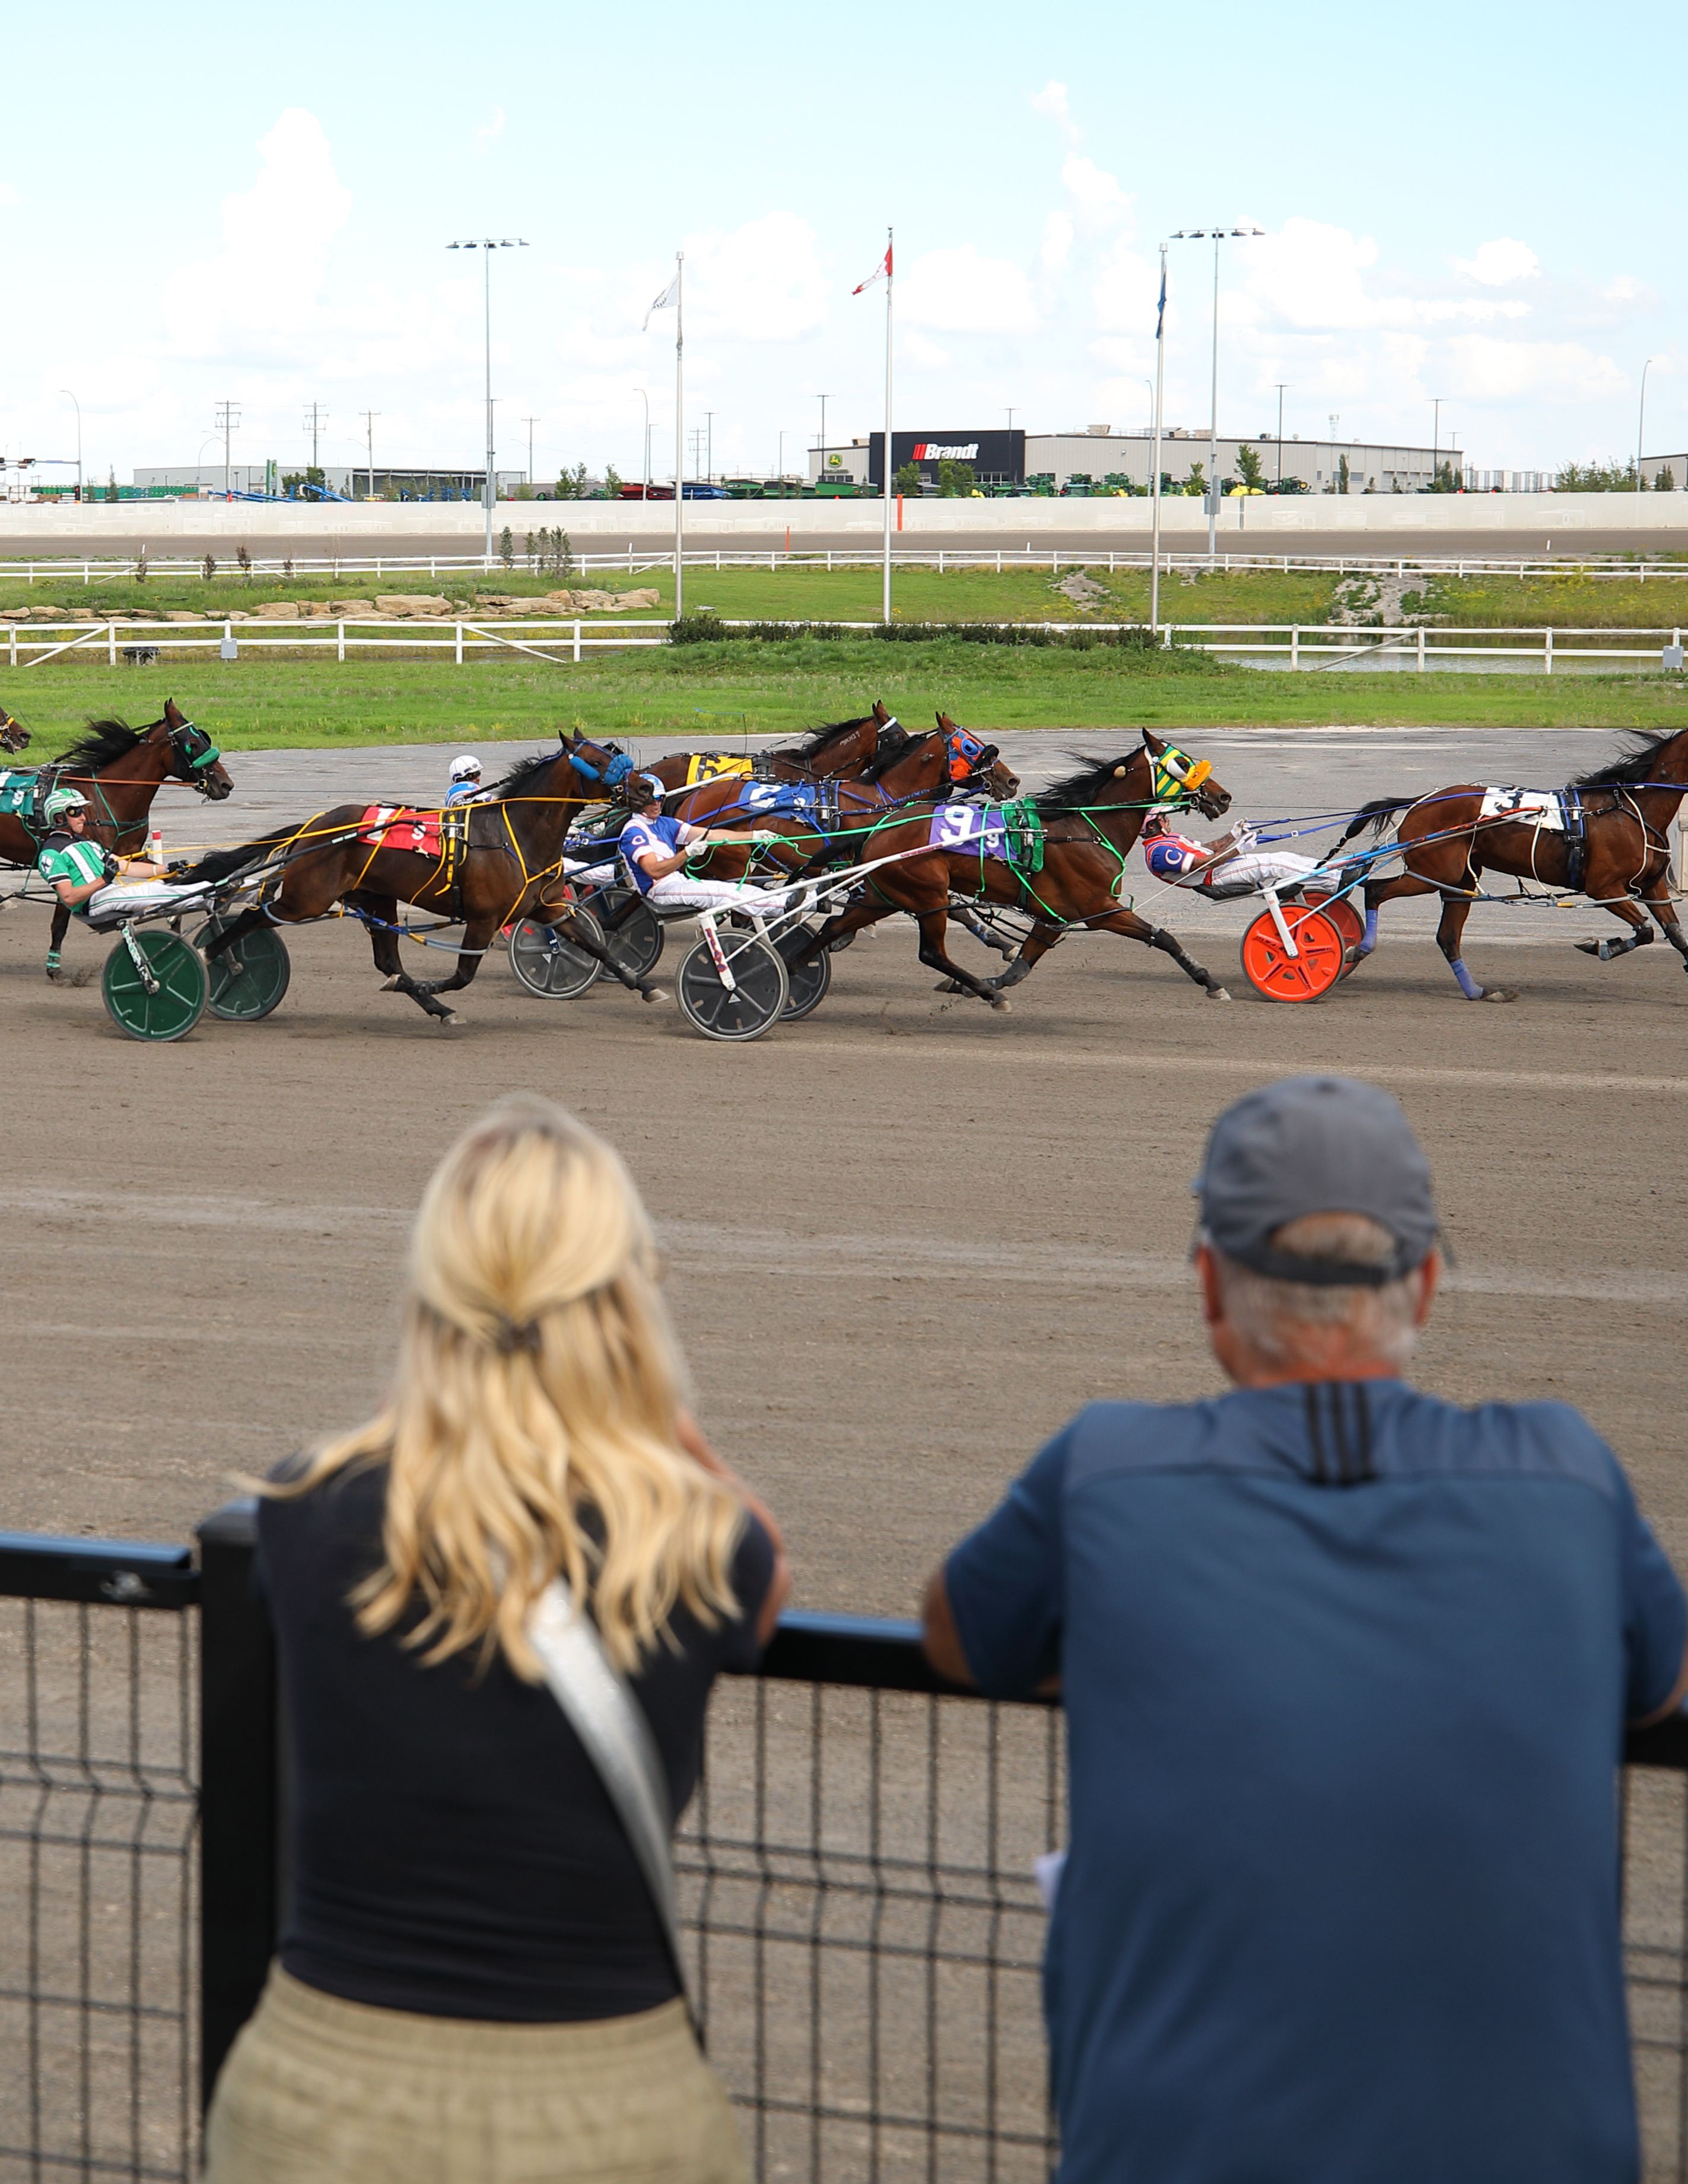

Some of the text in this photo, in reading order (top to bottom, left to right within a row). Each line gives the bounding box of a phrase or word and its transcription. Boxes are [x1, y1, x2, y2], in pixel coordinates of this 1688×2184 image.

[924, 443, 979, 460] Brandt
[12, 790, 25, 806] 9
[366, 808, 396, 842] 1
[940, 805, 975, 845] 9
[986, 832, 1000, 848] 9
[1165, 849, 1182, 865] C
